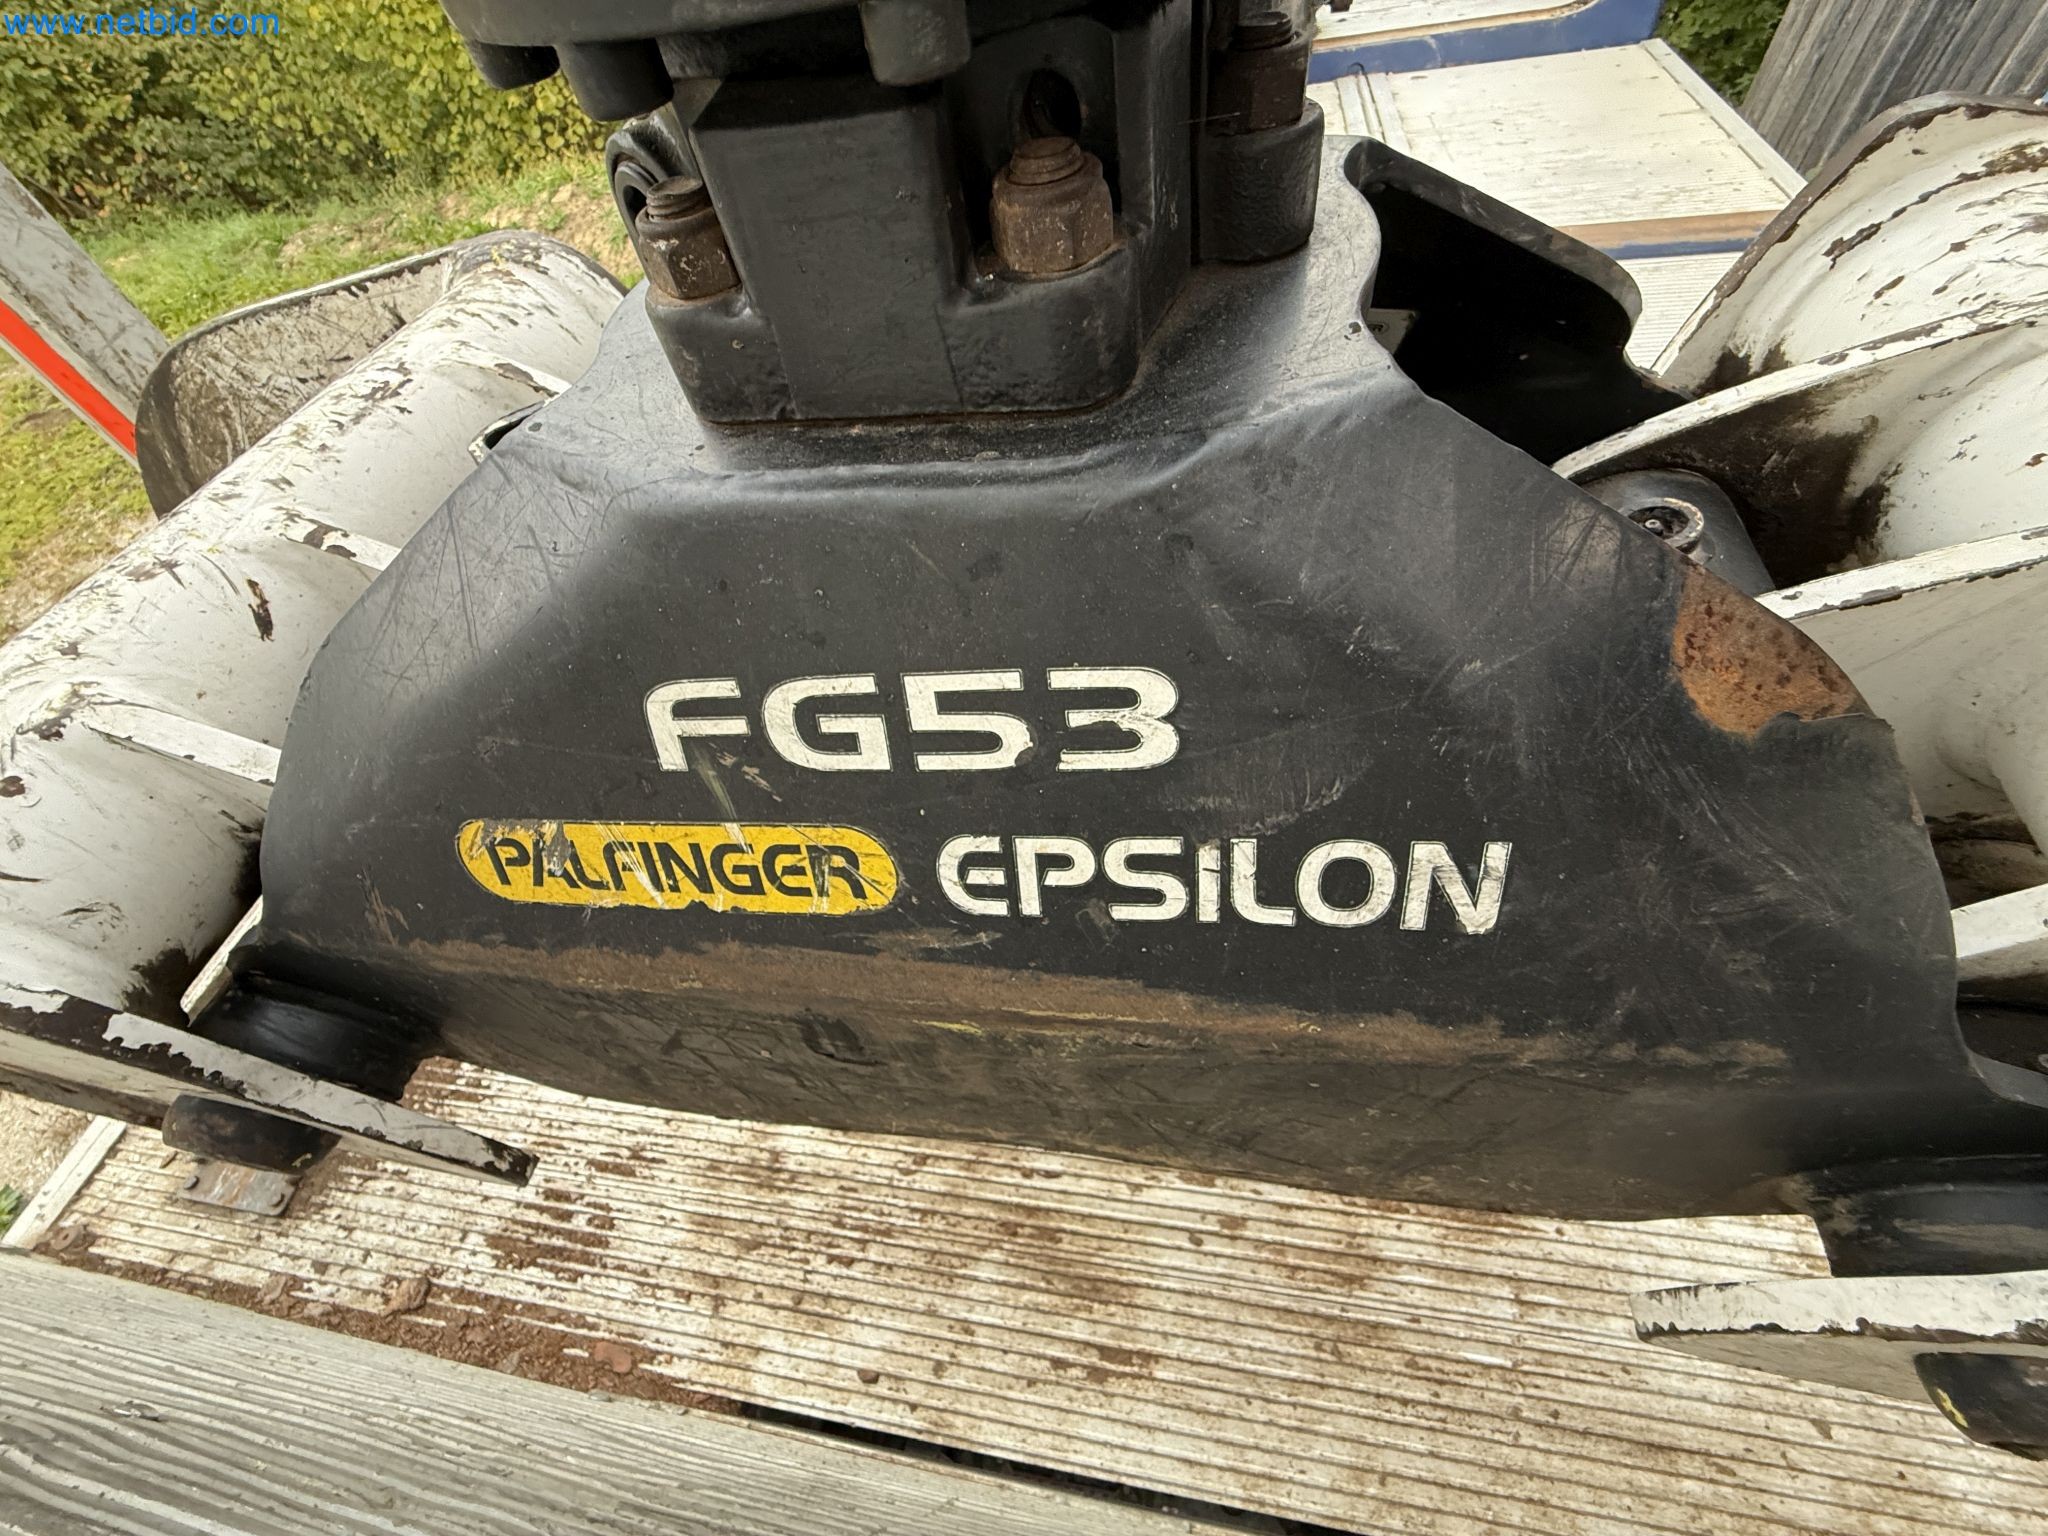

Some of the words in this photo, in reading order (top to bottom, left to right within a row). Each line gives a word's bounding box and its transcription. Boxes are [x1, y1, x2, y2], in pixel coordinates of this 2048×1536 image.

[643, 667, 1180, 771] FG53
[488, 838, 869, 901] PALFINGER
[936, 833, 1512, 934] EPSILON
